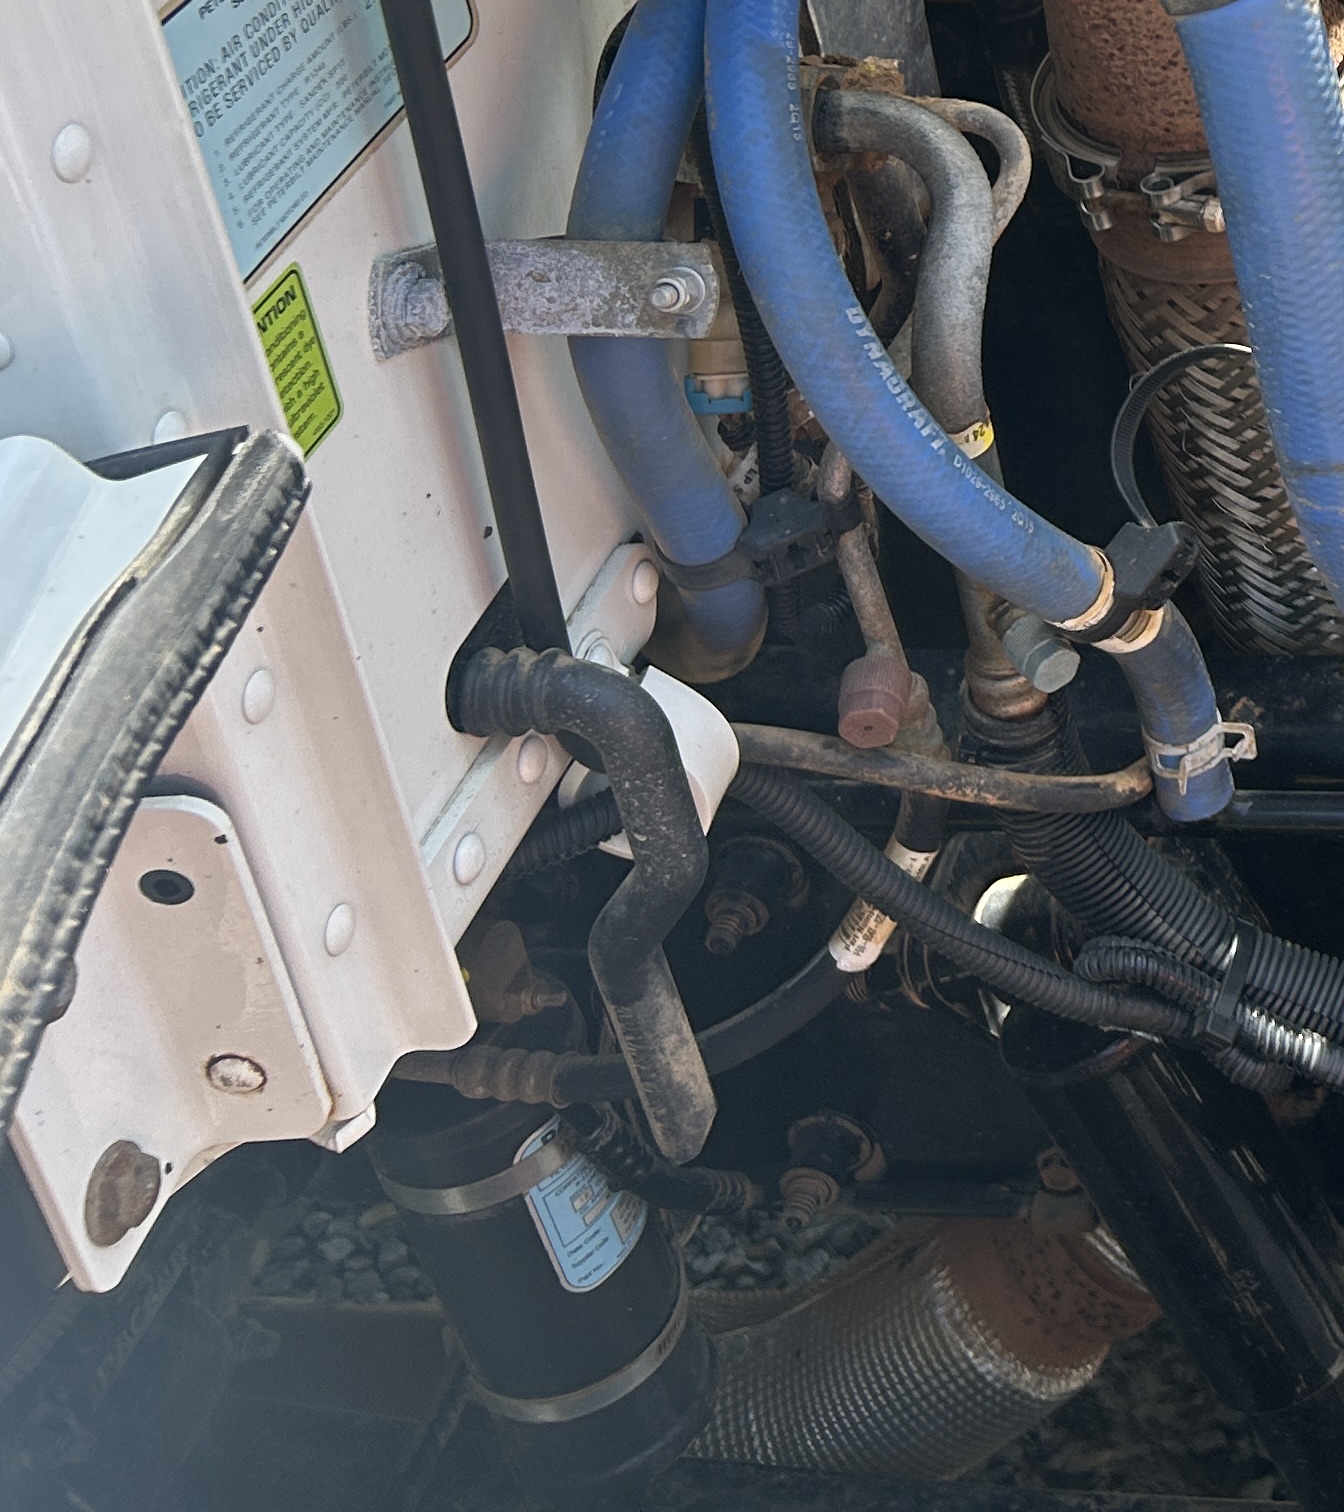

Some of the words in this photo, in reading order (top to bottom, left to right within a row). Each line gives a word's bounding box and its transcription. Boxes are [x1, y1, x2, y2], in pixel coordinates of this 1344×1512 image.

[182, 58, 221, 99] TION:
[220, 34, 243, 65] AIR
[249, 13, 291, 59] UNDER
[204, 102, 223, 127] BE
[223, 47, 281, 109] SERVICED
[282, 27, 298, 51] BY
[257, 285, 297, 333] NTION
[845, 306, 948, 450] DYNACRAFT
